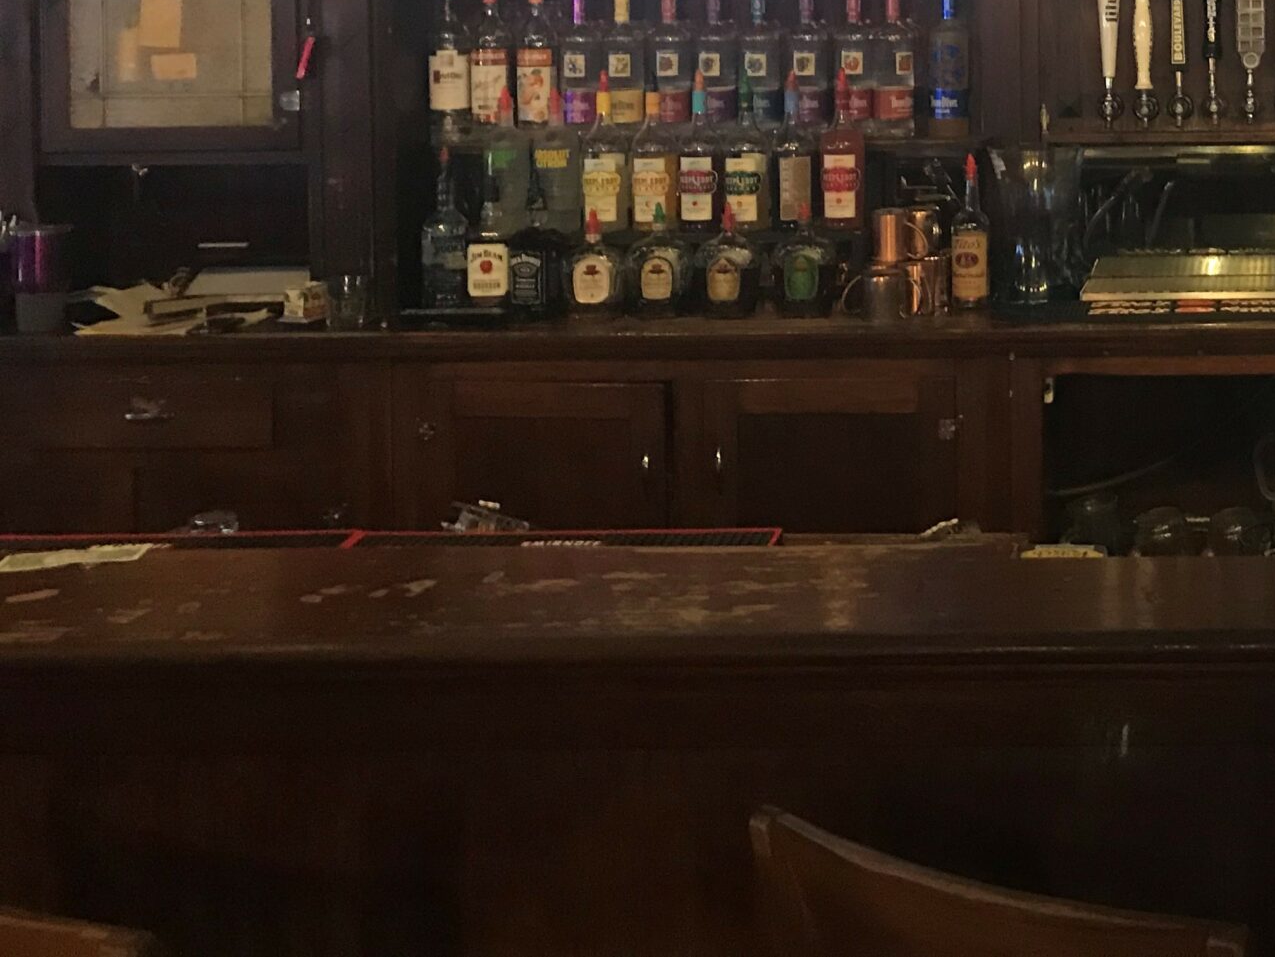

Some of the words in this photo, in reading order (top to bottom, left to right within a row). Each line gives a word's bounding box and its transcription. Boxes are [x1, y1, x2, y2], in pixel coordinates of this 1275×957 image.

[1173, 0, 1183, 62] BOULEVARD
[953, 237, 983, 251] Tito's
[521, 540, 602, 548] SMIRNOFF
